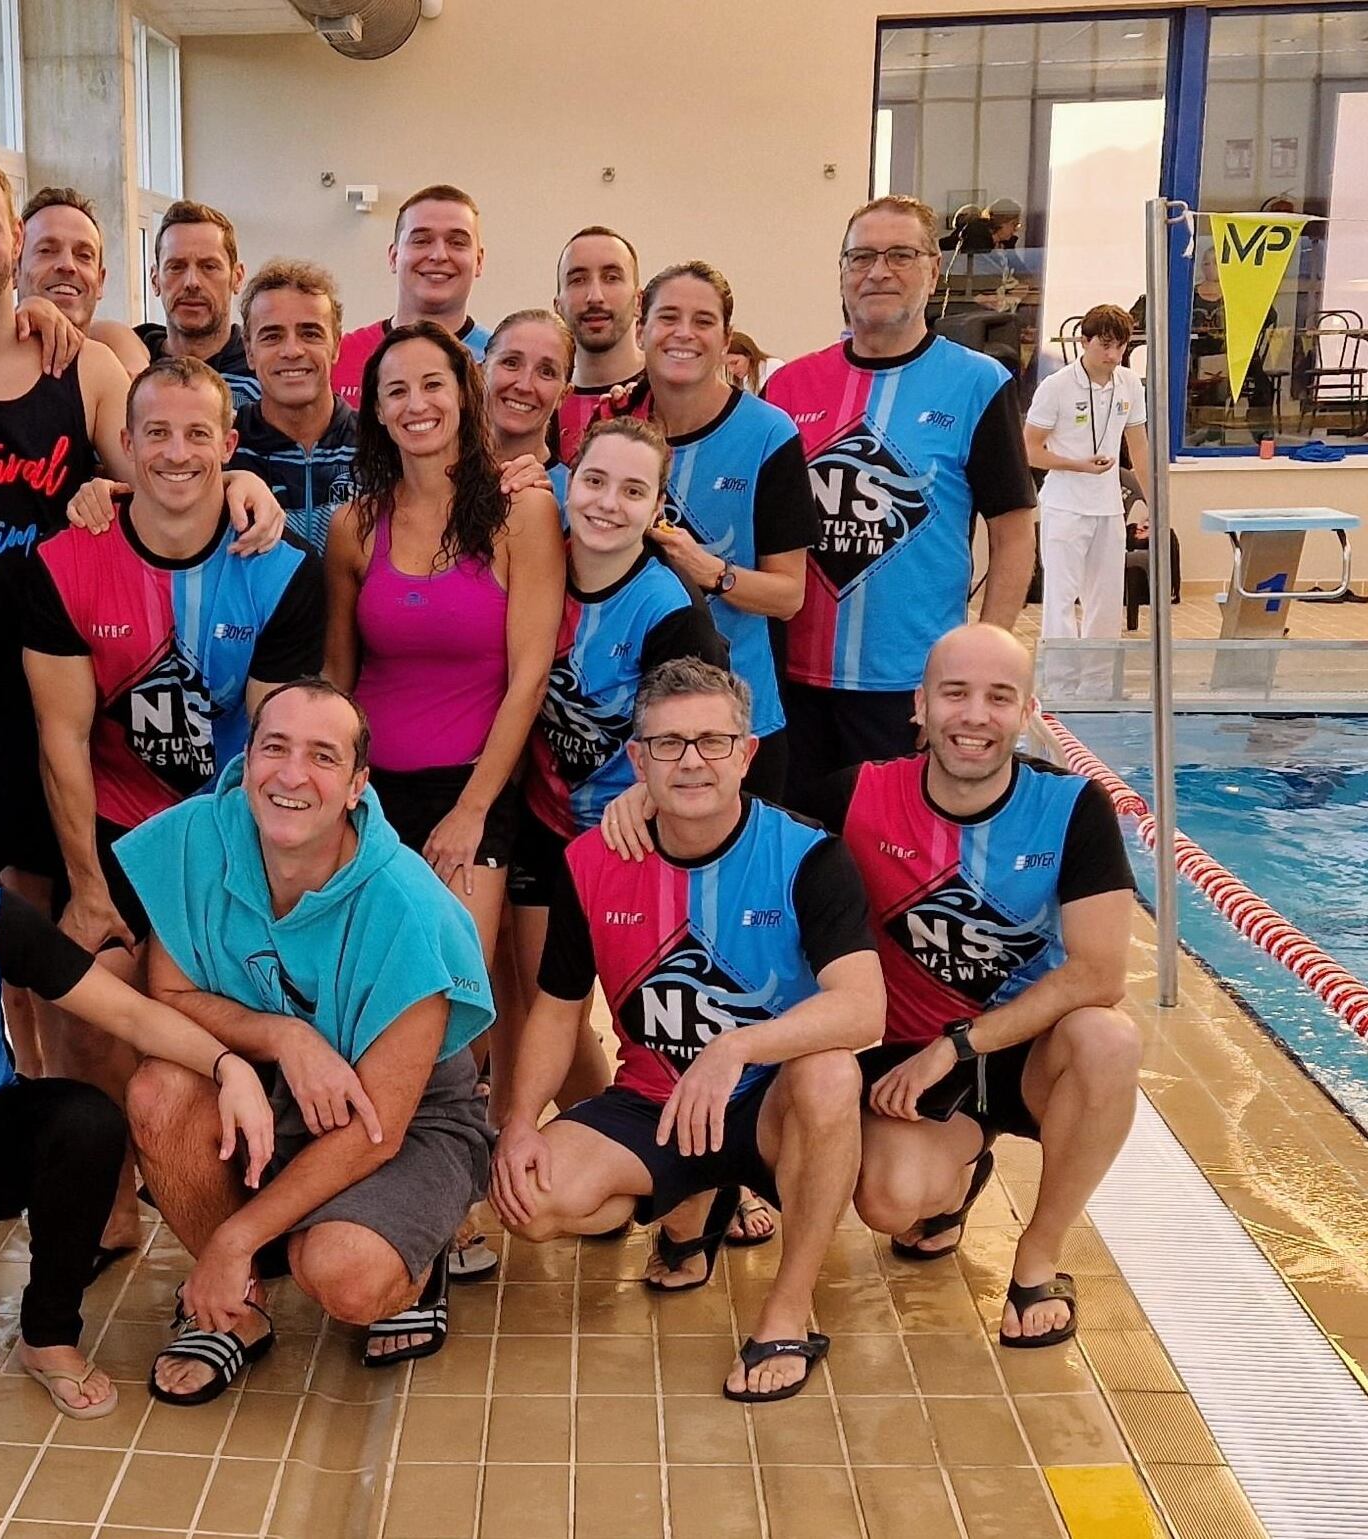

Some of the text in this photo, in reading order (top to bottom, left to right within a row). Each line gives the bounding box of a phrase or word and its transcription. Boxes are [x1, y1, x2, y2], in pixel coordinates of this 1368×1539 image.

[823, 520, 884, 540] TURAL
[1256, 573, 1288, 612] 1
[131, 691, 214, 748] NS
[907, 913, 1004, 960] NS
[642, 985, 737, 1044] NS
